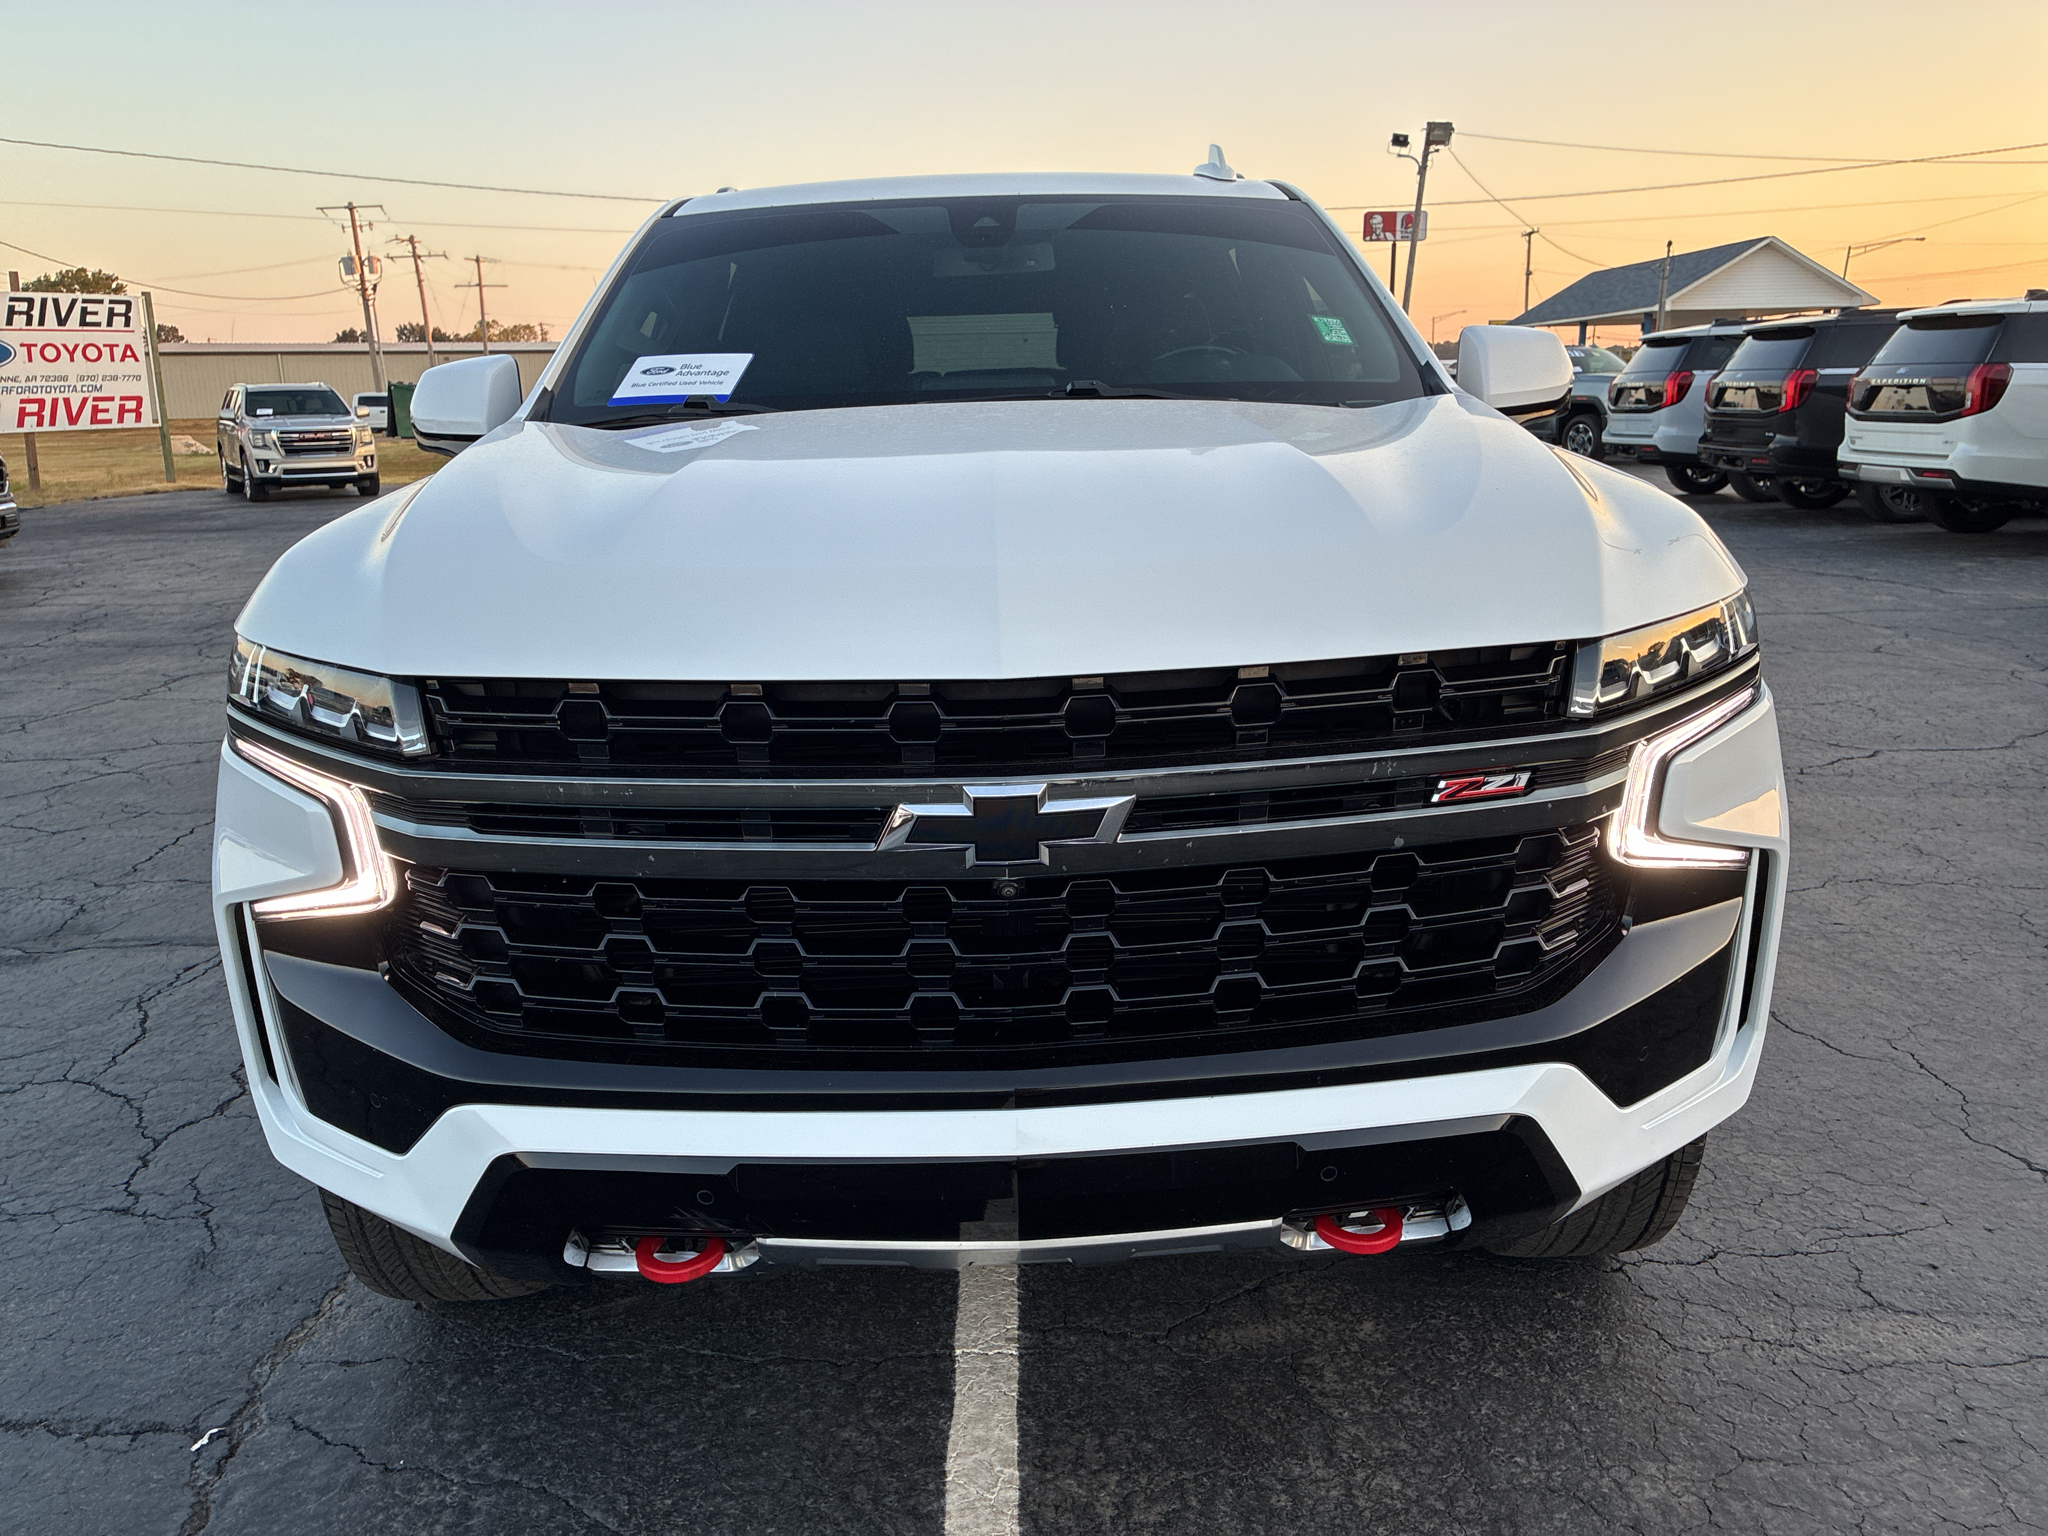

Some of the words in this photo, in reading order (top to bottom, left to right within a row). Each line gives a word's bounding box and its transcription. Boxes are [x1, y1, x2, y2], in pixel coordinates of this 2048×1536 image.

[5, 296, 133, 328] RIVER
[19, 342, 140, 363] TOYOTA
[0, 384, 103, 395] RFORDTOYOTA.COM
[16, 395, 144, 429] RIVER
[1431, 771, 1532, 803] Z71
